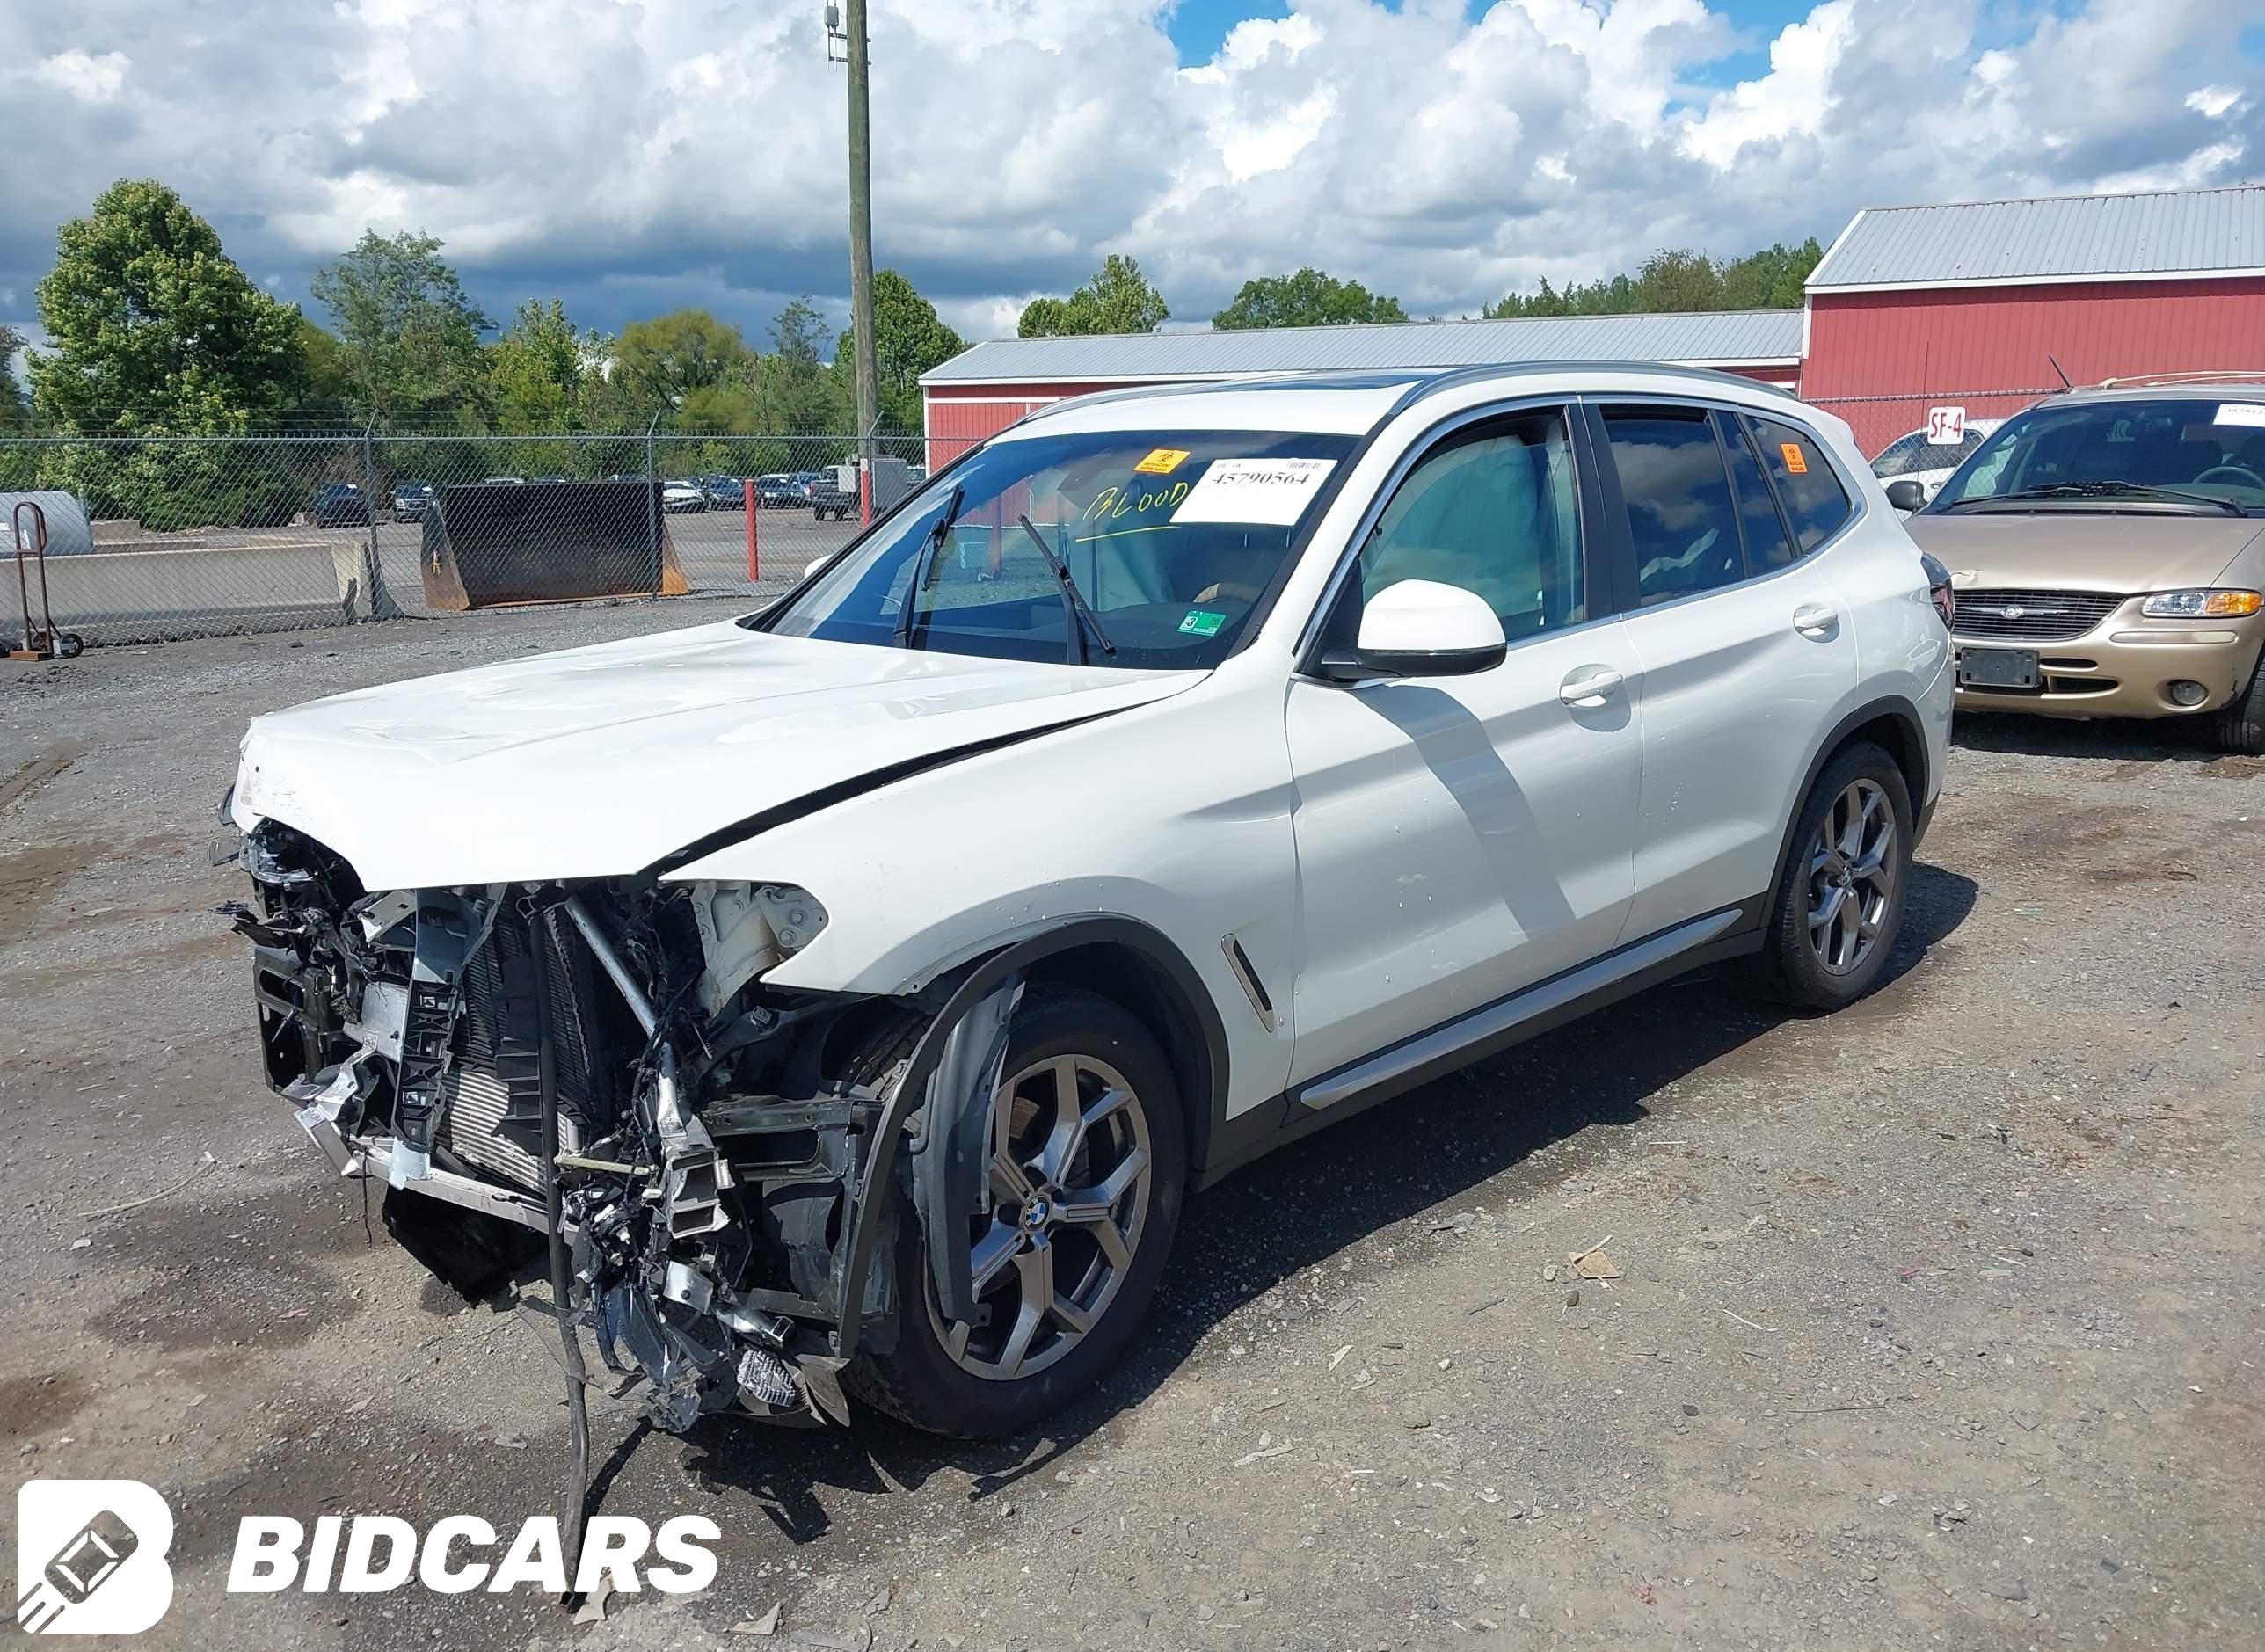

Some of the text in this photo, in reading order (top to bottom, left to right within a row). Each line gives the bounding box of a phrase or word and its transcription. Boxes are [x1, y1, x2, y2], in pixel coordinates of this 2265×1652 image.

[1930, 412, 1963, 439] SF-4
[1212, 471, 1310, 485] 45790564
[1082, 482, 1188, 521] BLOOD
